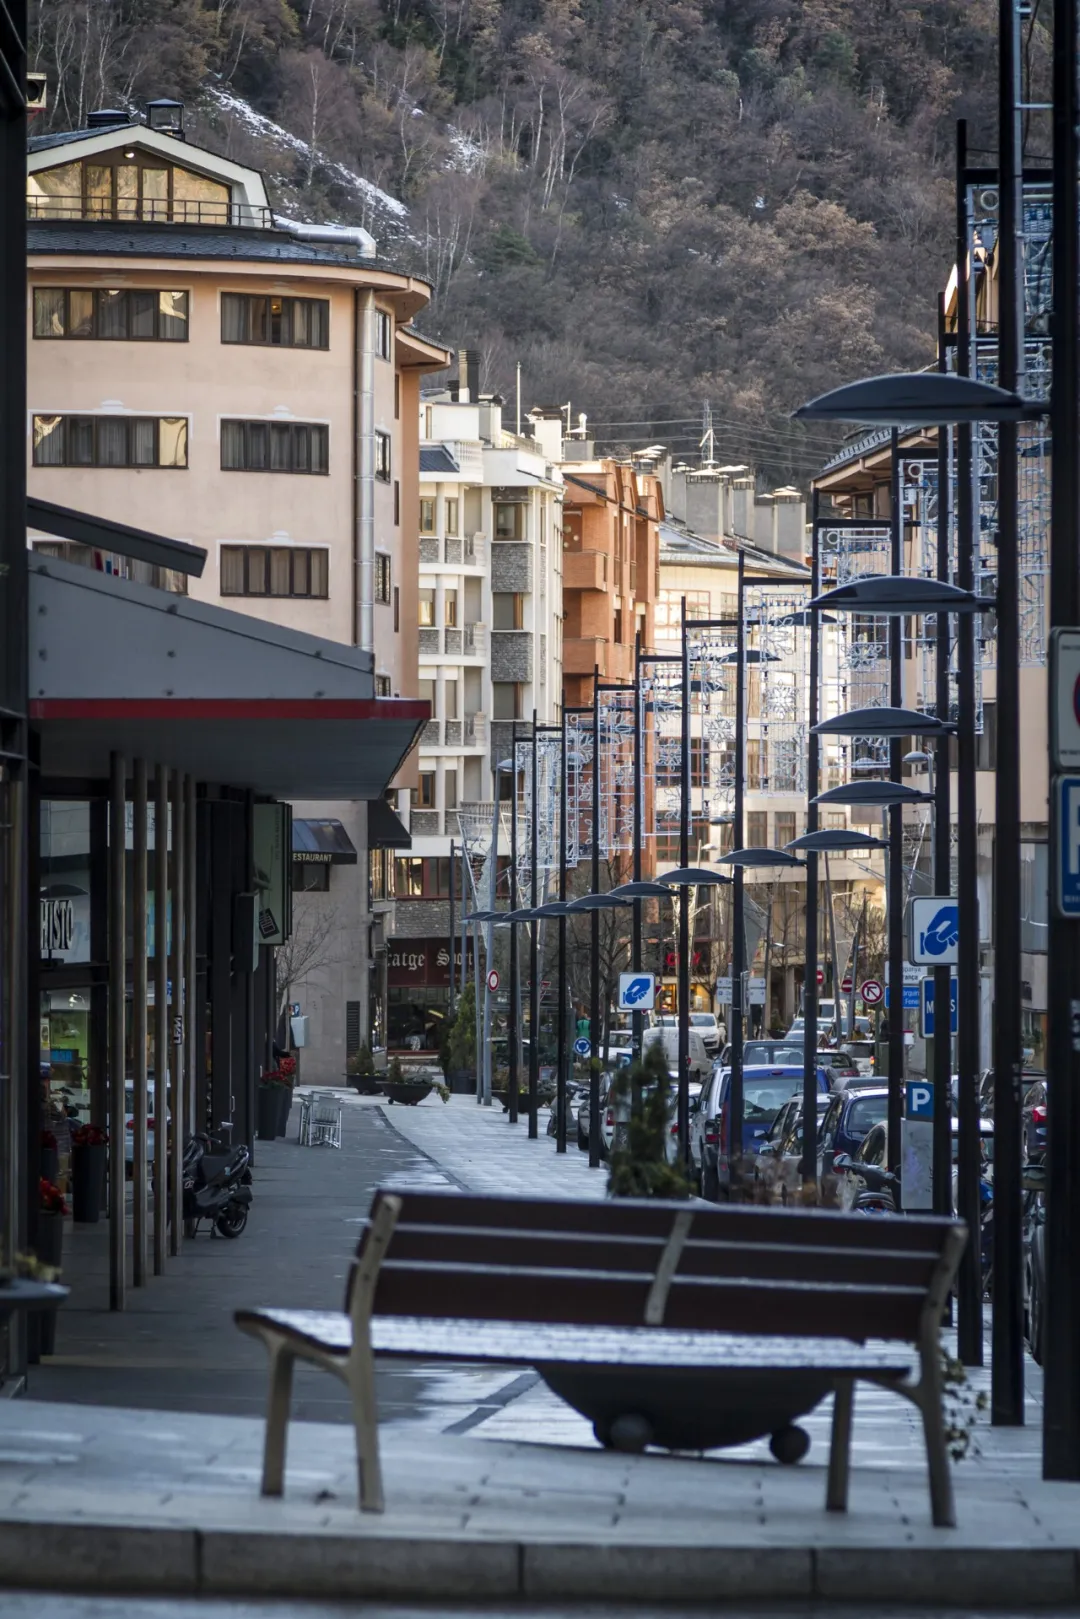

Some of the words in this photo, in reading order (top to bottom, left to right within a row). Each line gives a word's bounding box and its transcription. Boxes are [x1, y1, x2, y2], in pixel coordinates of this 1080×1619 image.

[293, 852, 332, 862] ESTAURANT
[436, 948, 473, 967] Sot
[912, 1088, 931, 1112] P
